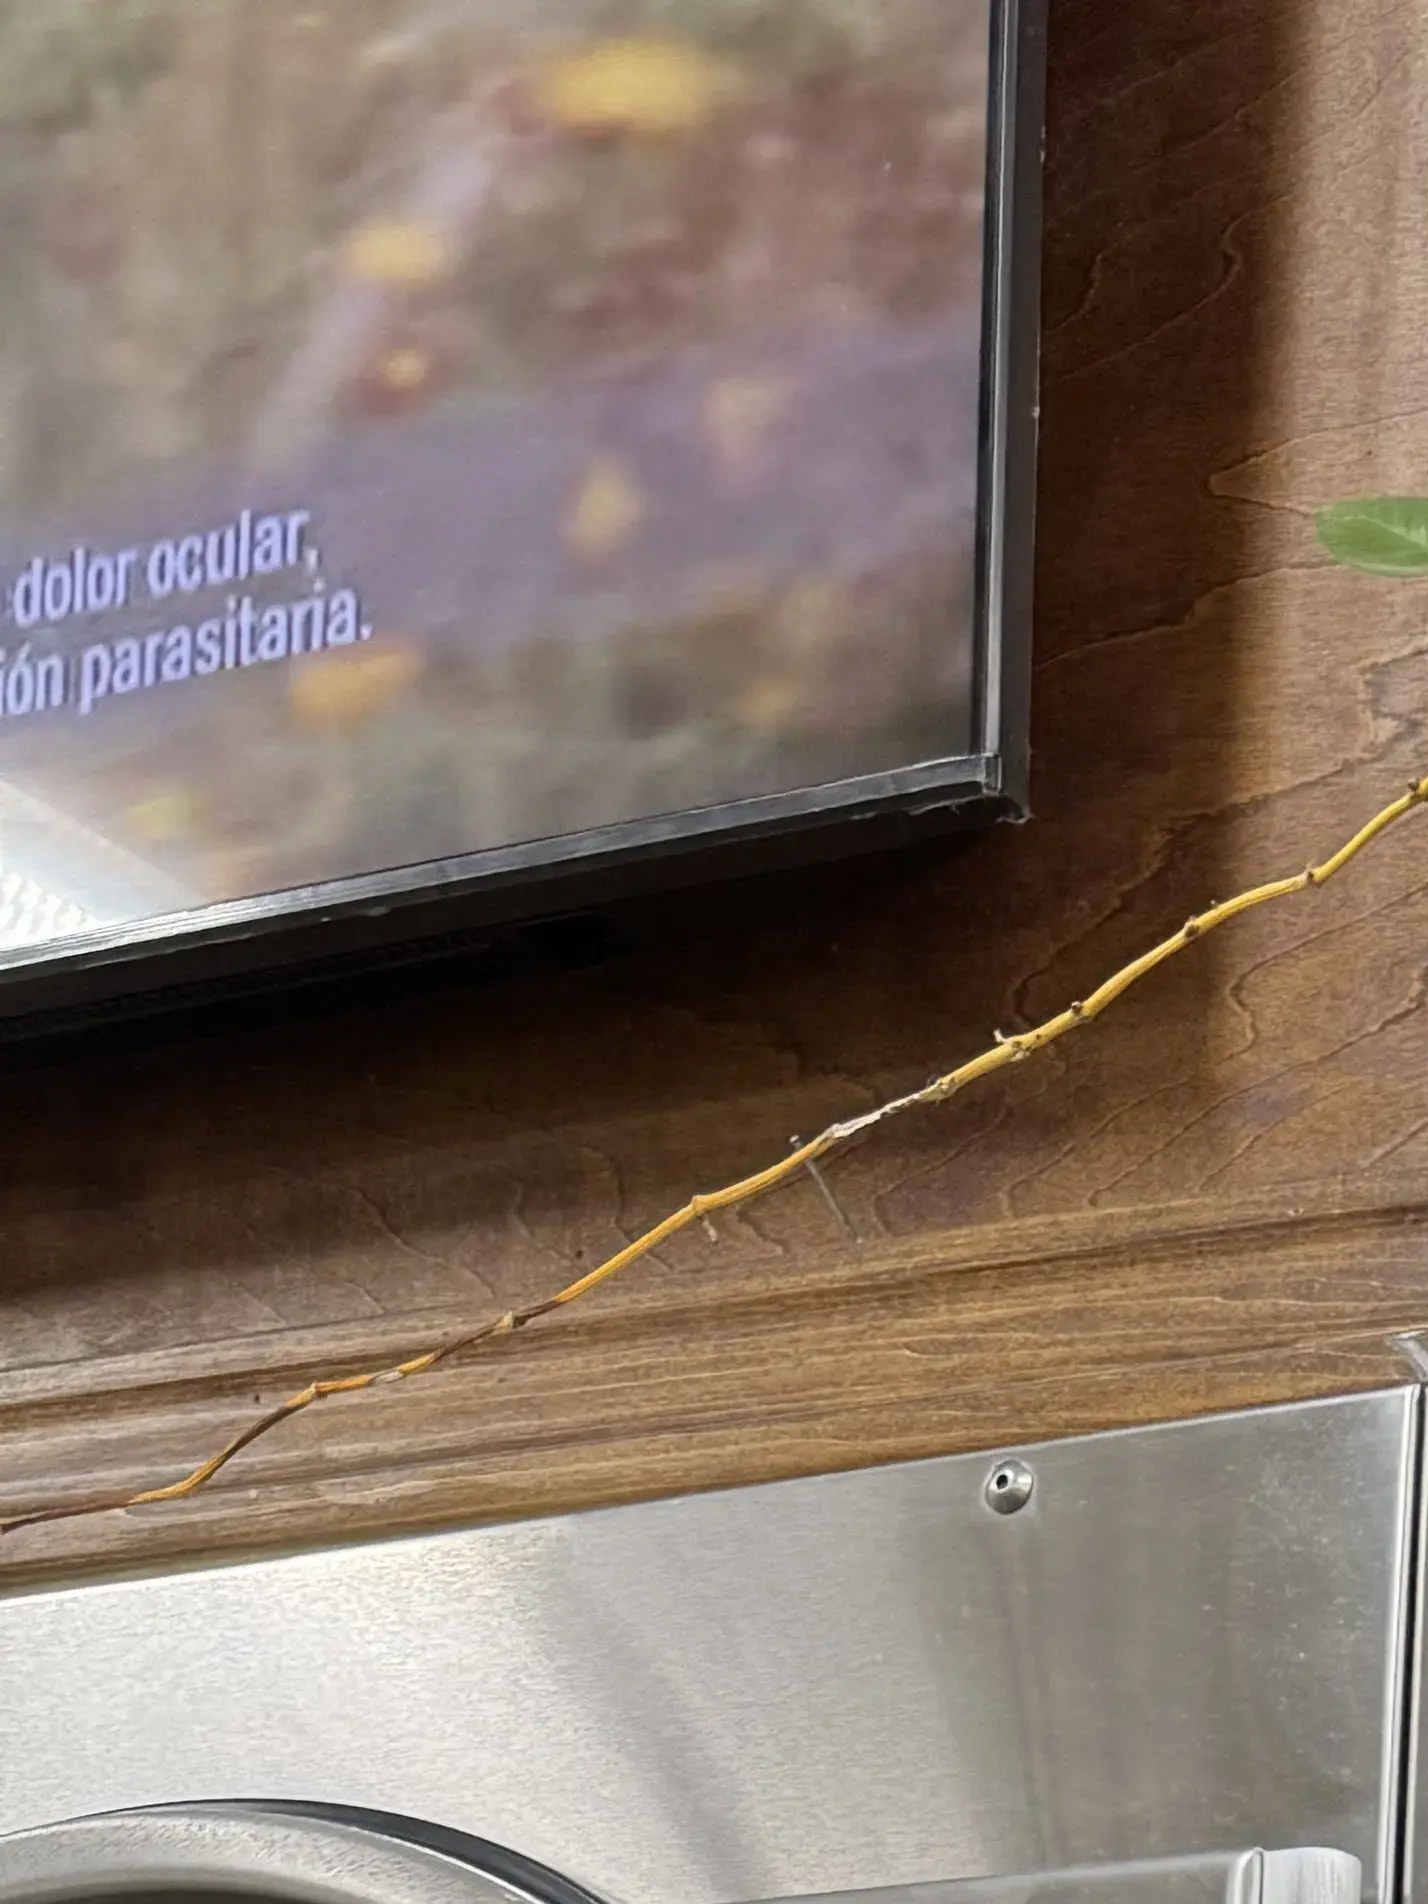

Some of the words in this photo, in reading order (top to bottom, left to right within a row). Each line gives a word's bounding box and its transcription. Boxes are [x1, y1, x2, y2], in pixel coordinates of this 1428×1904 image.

[13, 547, 138, 628] dolor
[147, 509, 319, 597] ocular,
[78, 579, 374, 718] parasitaria.
